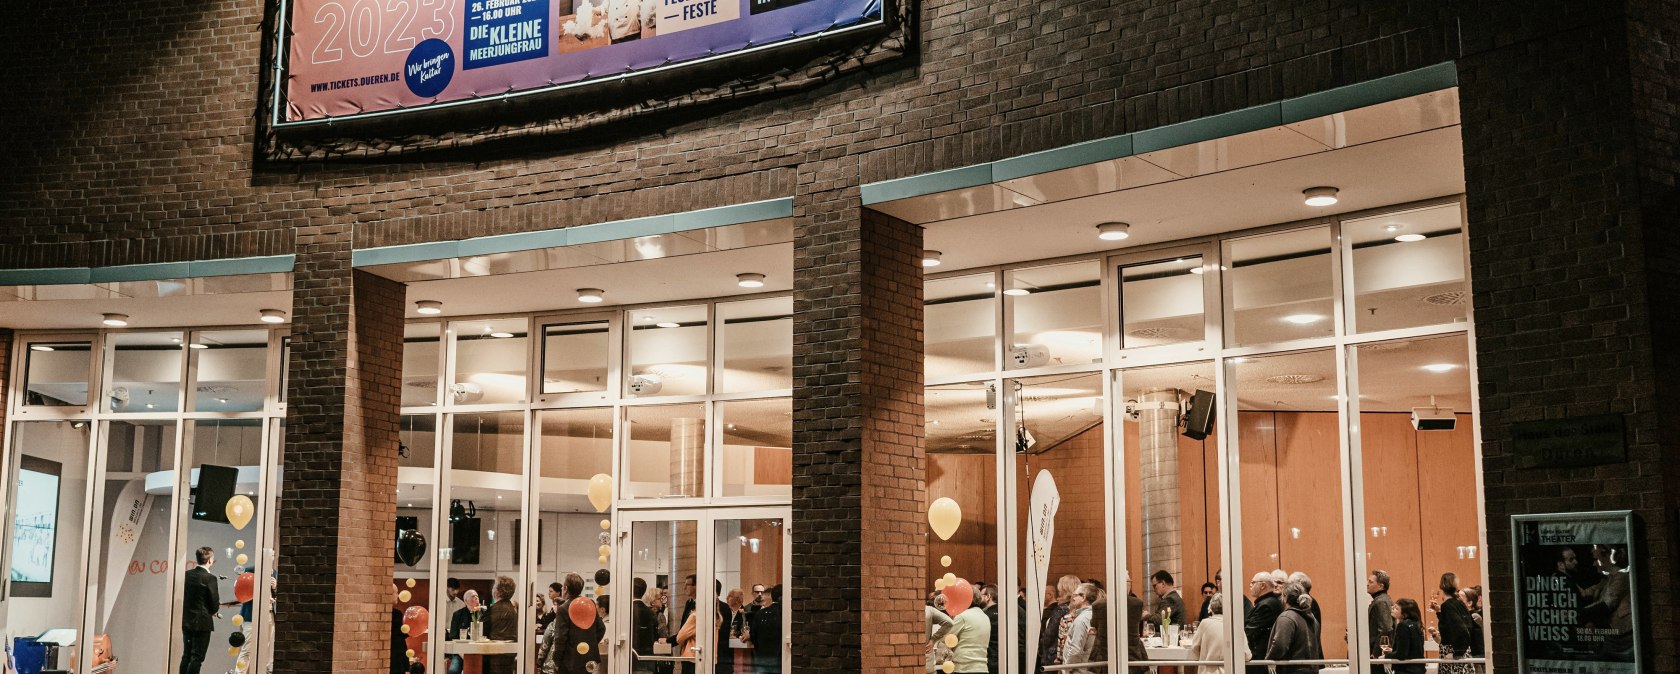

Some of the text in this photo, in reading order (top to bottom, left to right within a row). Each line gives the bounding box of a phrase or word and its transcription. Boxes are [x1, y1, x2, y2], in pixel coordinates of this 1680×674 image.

[471, 2, 484, 13] 26.
[482, 6, 522, 21] 16.00 UHR
[683, 0, 718, 20] FESTE
[312, 0, 455, 64] 2023
[470, 19, 542, 45] DIE KLEINE
[469, 38, 542, 61] MEERJUNGFRAU
[408, 52, 450, 76] Wir bringen
[310, 72, 400, 93] WWW.TICKETS.DUEREN.DE
[420, 66, 442, 83] Kultur
[1541, 535, 1576, 543] THEATER
[1526, 575, 1571, 593] DINGE,
[1527, 593, 1578, 608] DIE ICH
[1527, 609, 1578, 625] SICHER
[1528, 625, 1570, 641] WEISS
